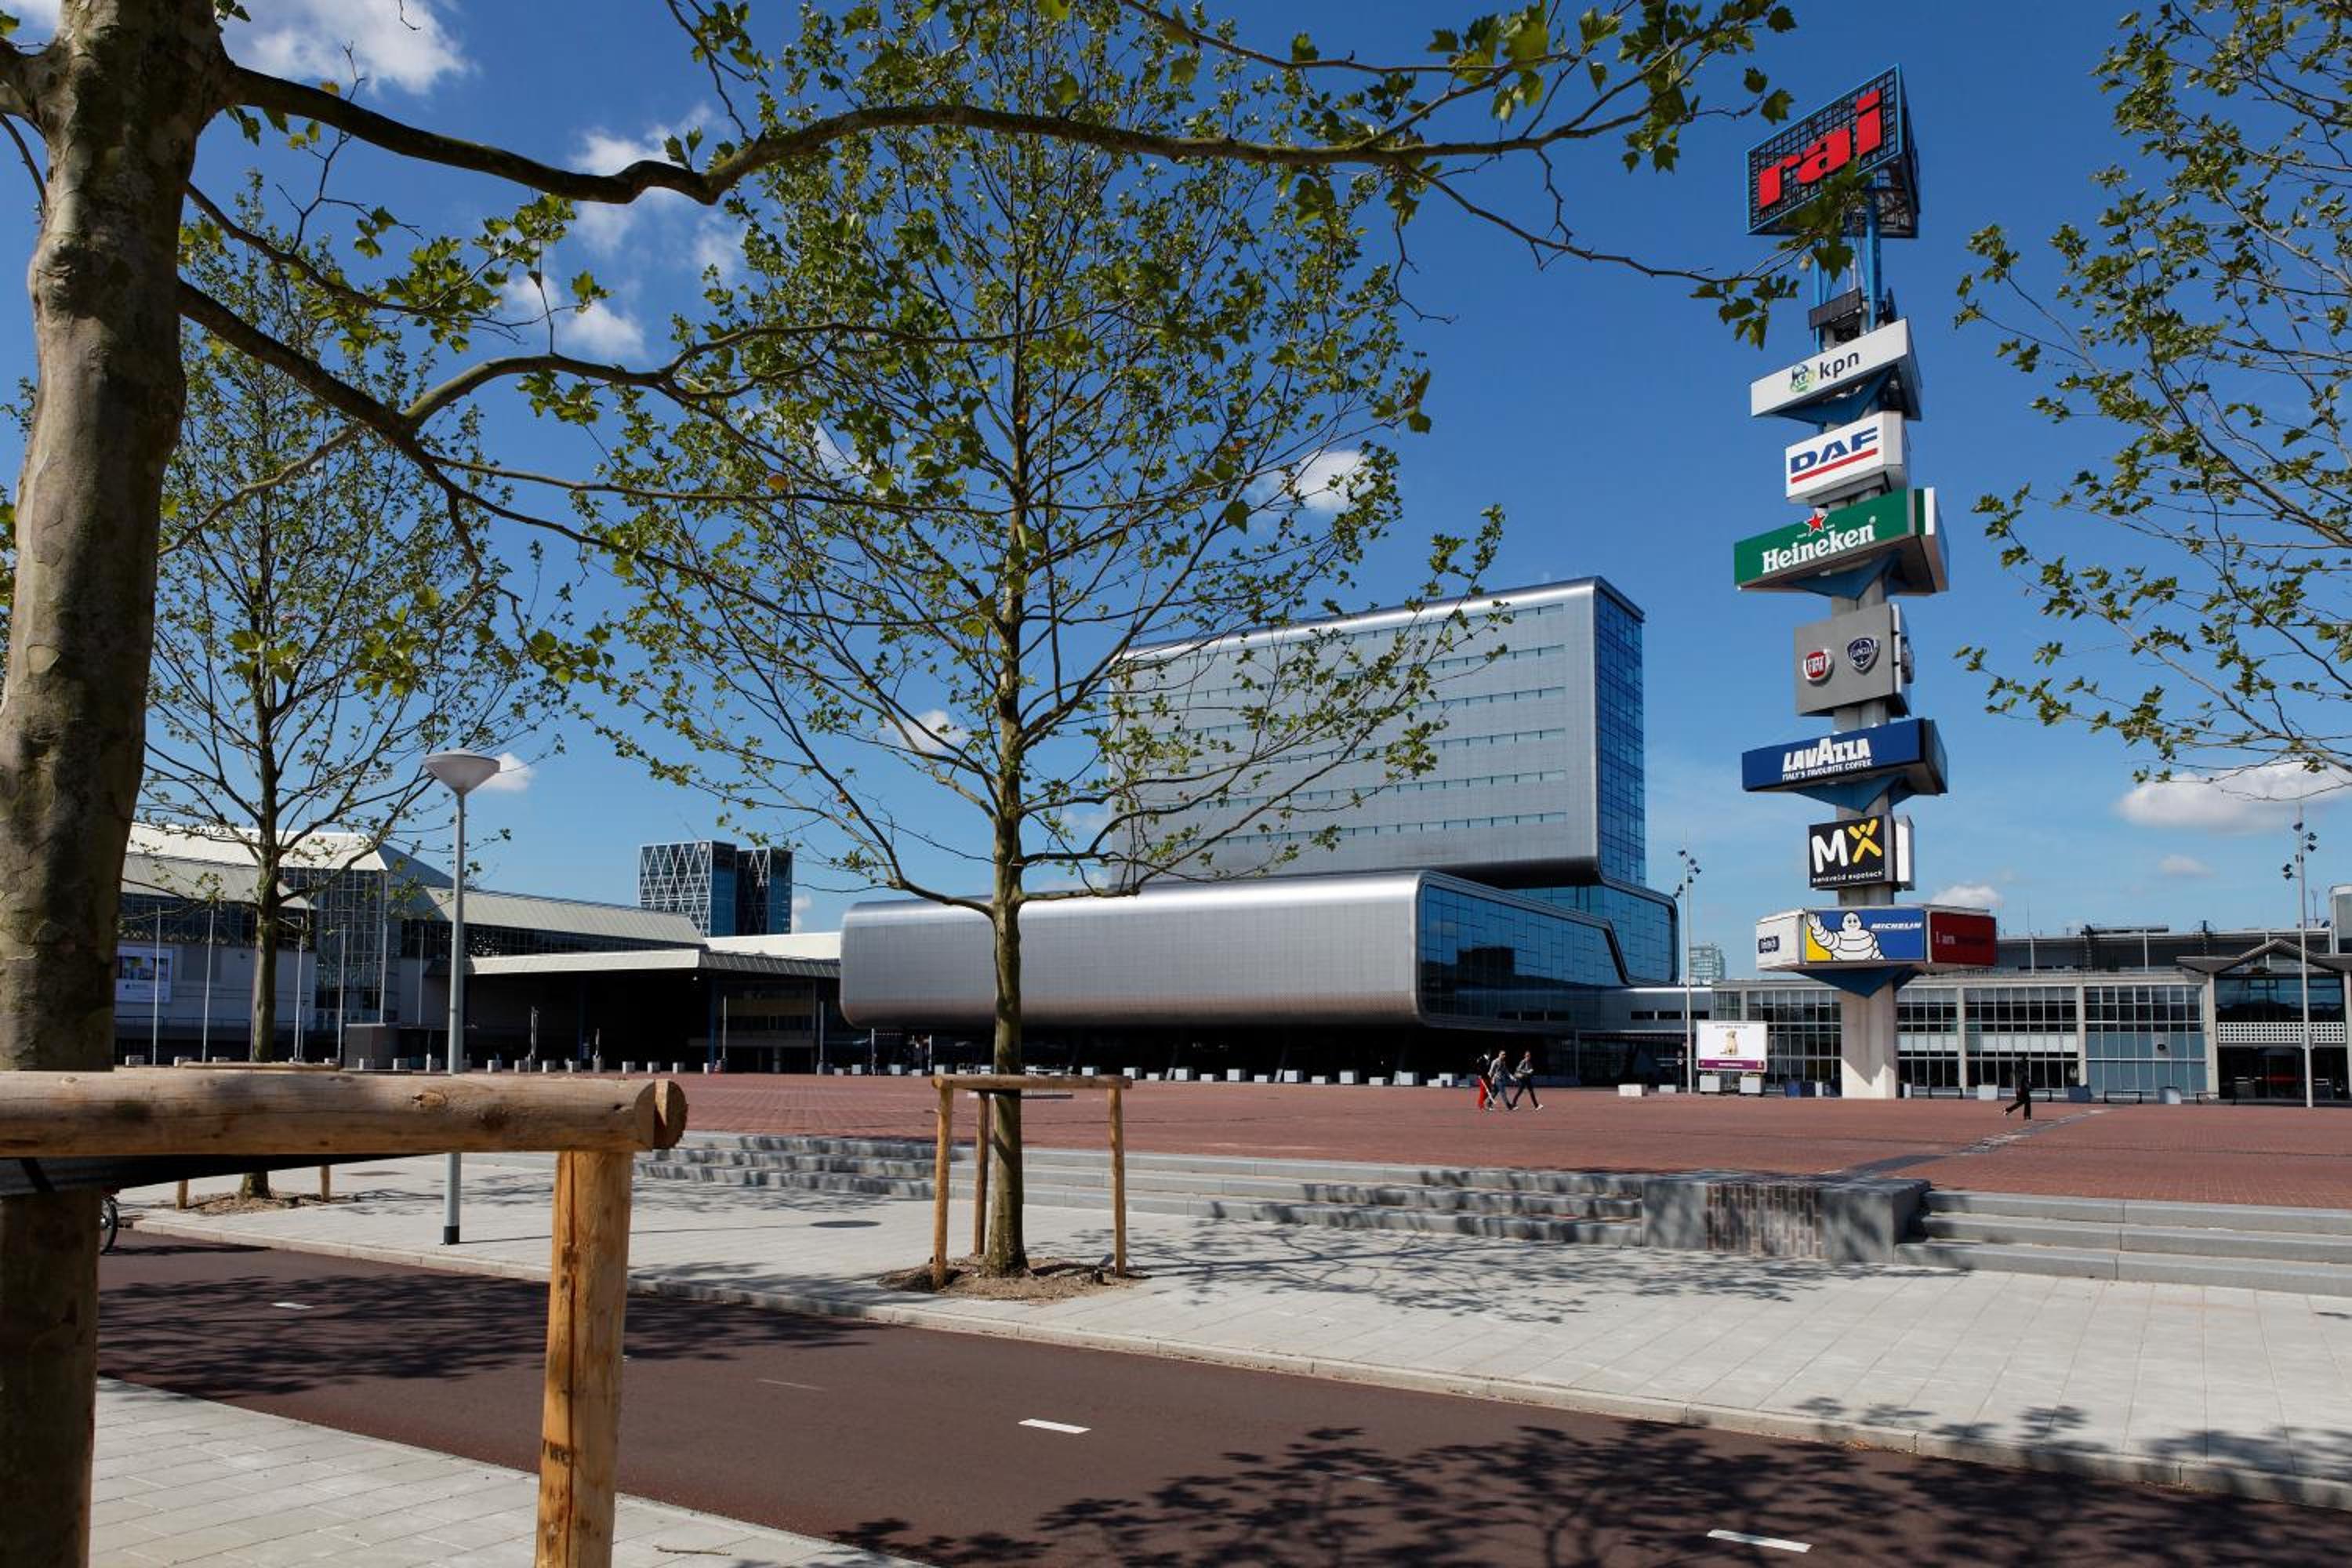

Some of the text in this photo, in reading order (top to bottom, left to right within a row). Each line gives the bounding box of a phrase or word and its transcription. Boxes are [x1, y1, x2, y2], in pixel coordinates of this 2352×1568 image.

[1759, 88, 1881, 206] rai
[1820, 353, 1860, 379] kpn
[1791, 426, 1878, 474] DAF
[1762, 524, 1876, 573] Heineken
[1782, 738, 1871, 772] LAVAZZA
